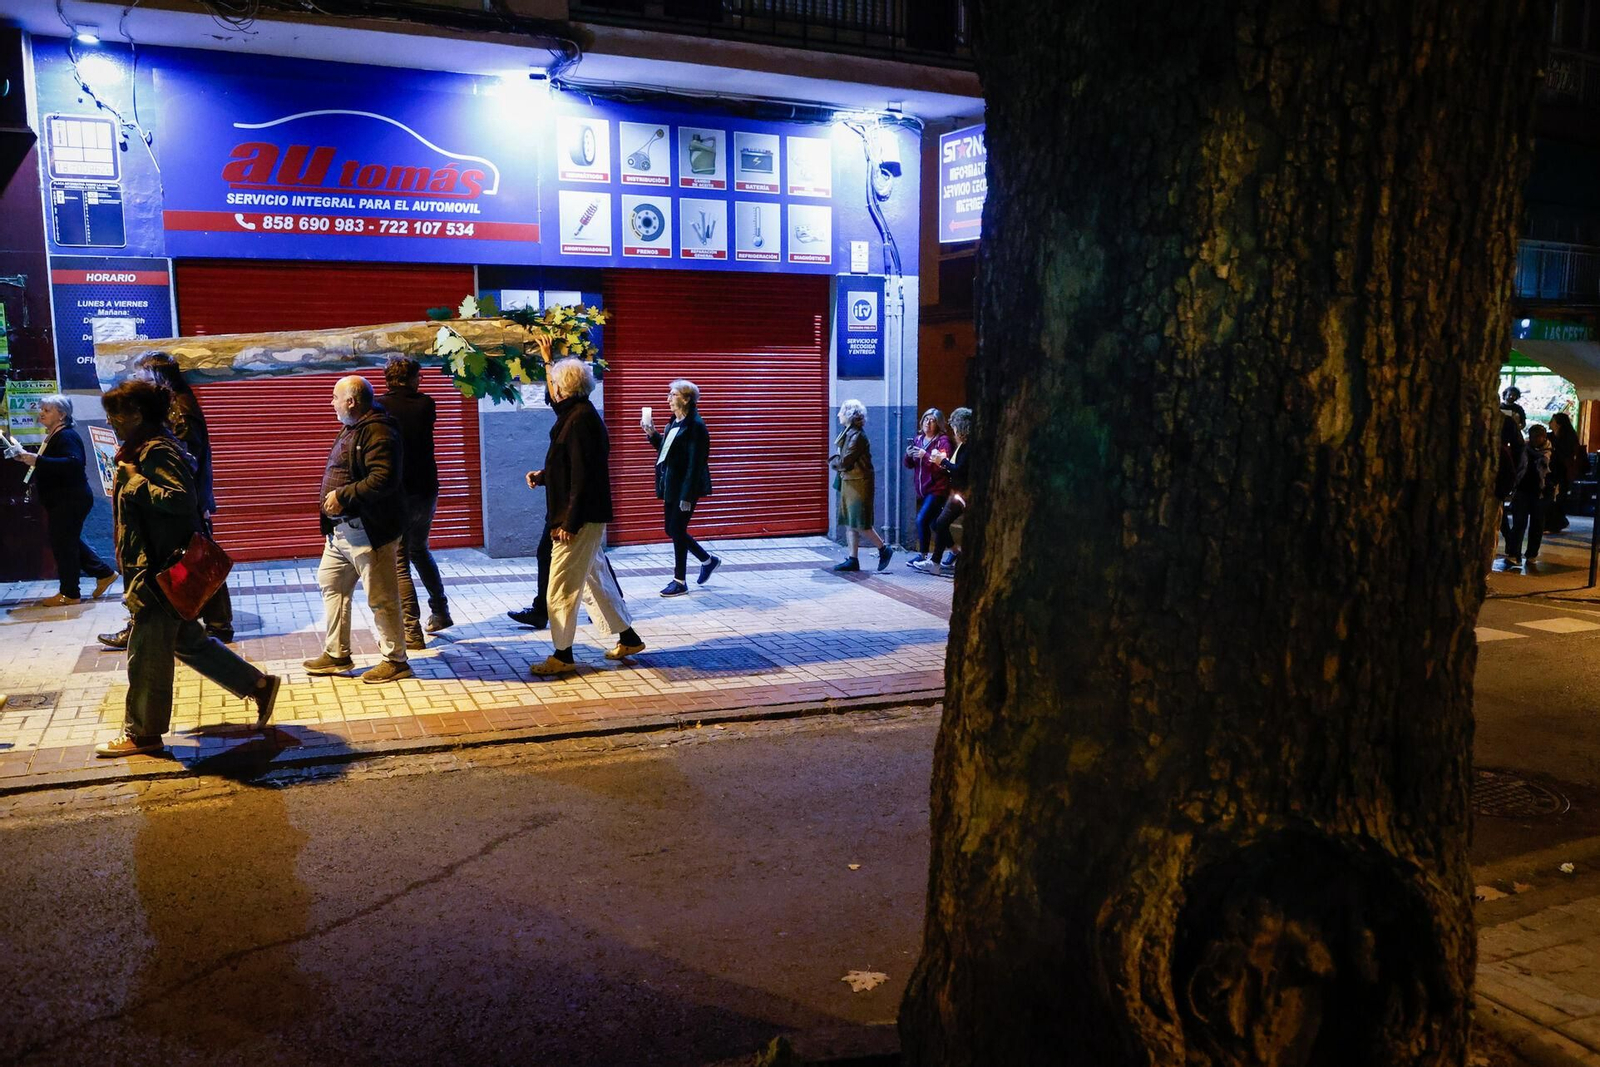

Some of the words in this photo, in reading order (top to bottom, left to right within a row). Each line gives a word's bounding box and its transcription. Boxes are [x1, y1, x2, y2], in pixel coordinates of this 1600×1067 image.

[339, 162, 486, 199] tomás
[745, 183, 770, 191] BATERÍA
[226, 193, 288, 206] SERVICIO
[292, 196, 355, 209] INTEGRAL
[359, 198, 391, 211] PARA
[394, 200, 409, 211] EL
[412, 200, 481, 214] AUTOMOVIL
[262, 216, 294, 230] 858
[299, 217, 330, 231] 690
[334, 218, 364, 232] 983
[379, 220, 408, 234] 722
[413, 221, 442, 235] 107
[446, 222, 475, 236] 534
[86, 273, 136, 282] HORARIO
[77, 300, 105, 308] LUNES
